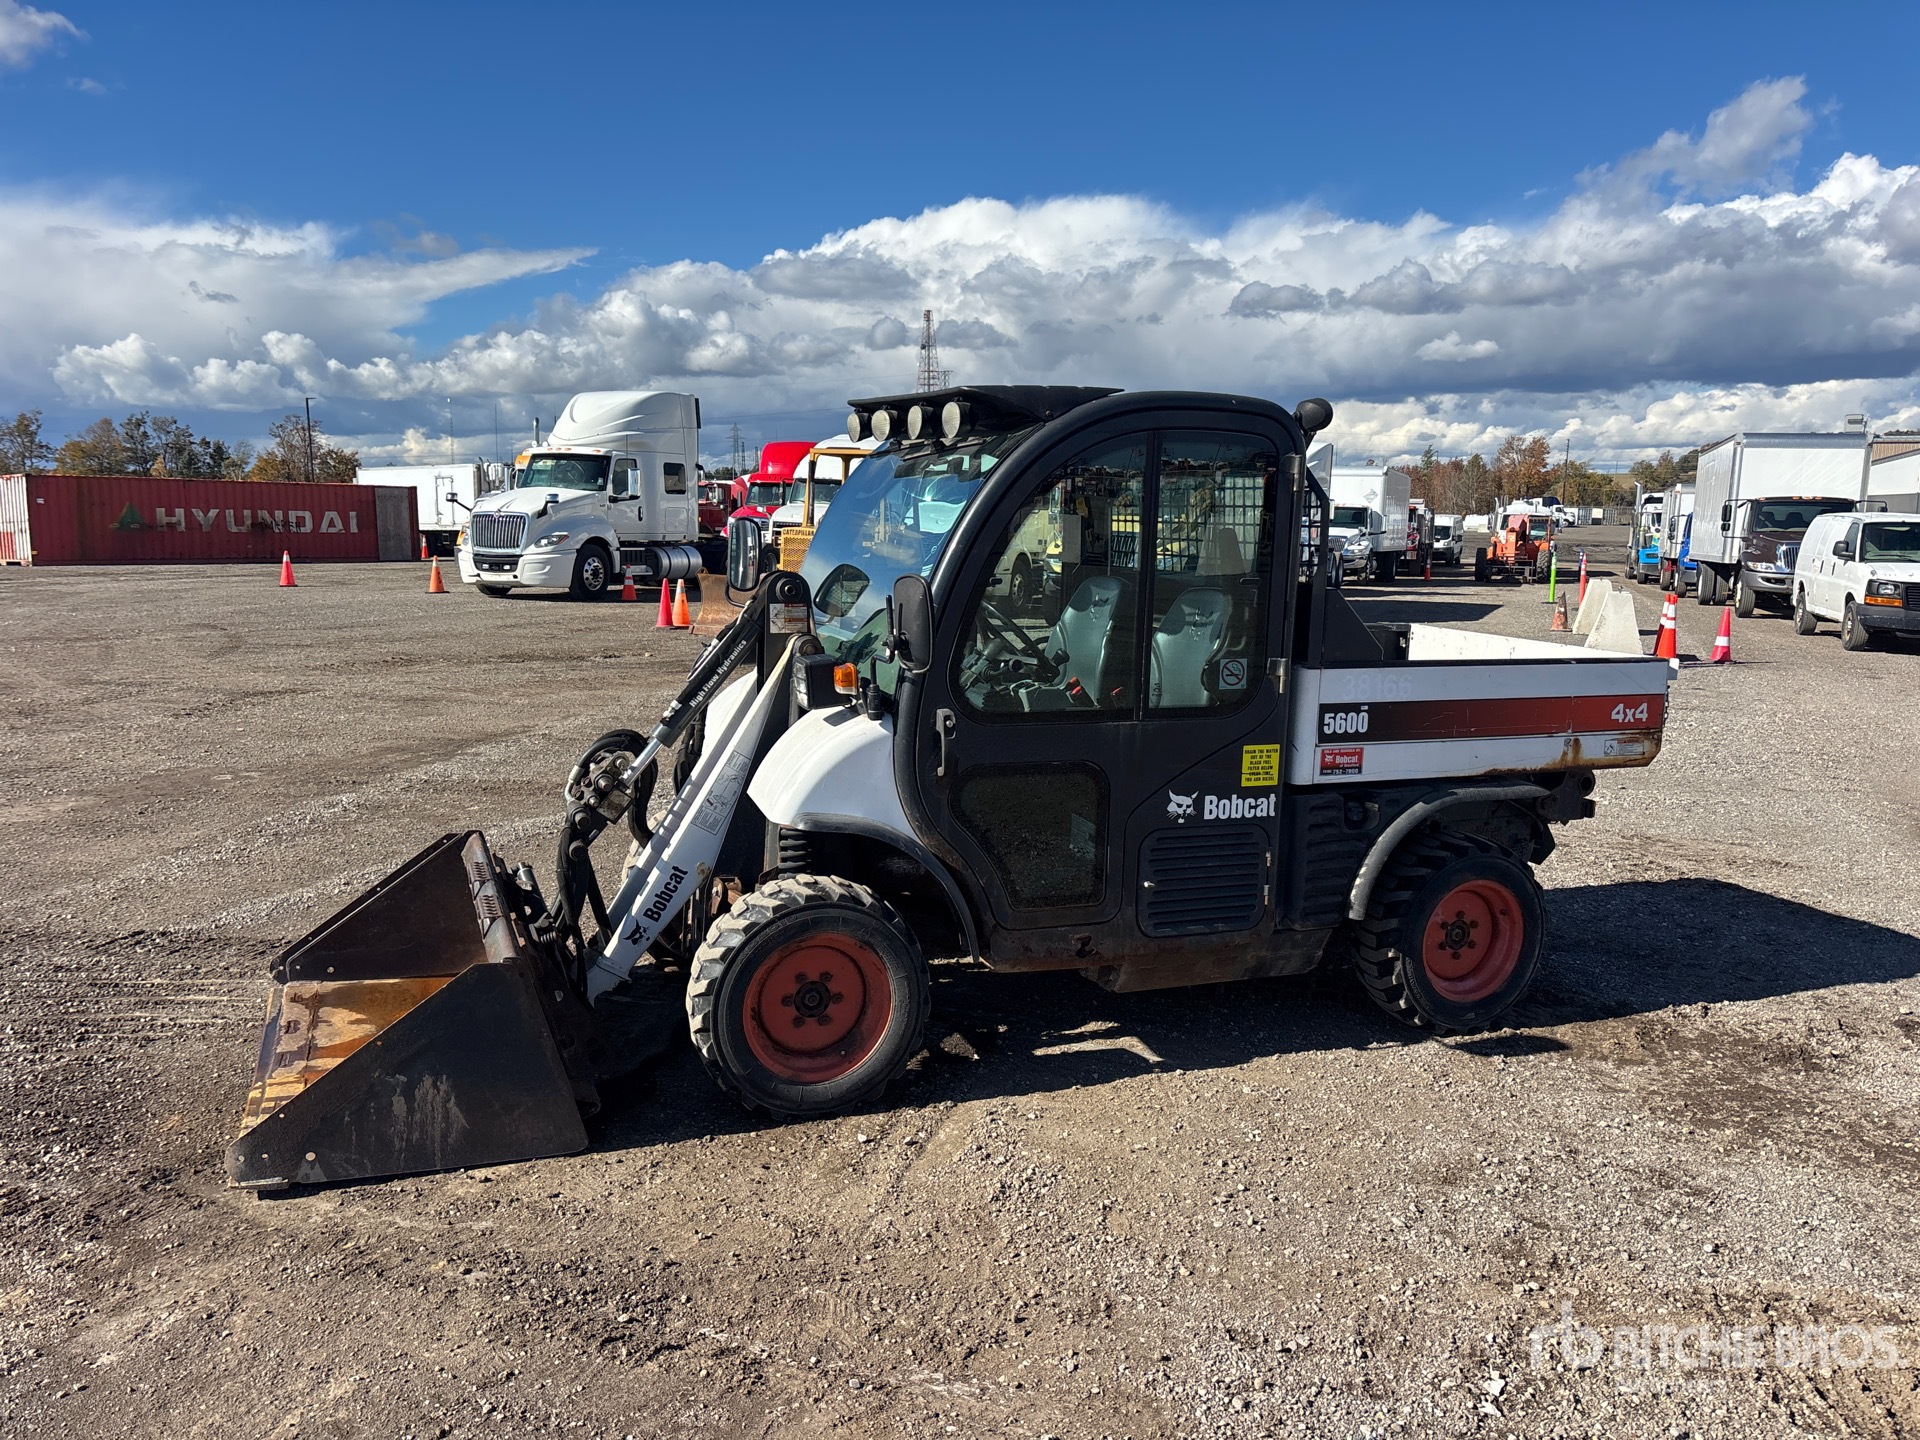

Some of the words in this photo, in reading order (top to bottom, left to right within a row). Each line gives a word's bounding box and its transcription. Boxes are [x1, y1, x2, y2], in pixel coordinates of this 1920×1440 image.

[155, 507, 358, 533] HYUNDAI
[782, 528, 815, 536] CATERPILLAR
[689, 690, 706, 707] High
[702, 674, 719, 692] Flow
[716, 639, 747, 675] Hydraulics
[1323, 711, 1369, 734] 5600
[1611, 702, 1648, 723] 4x4
[1335, 754, 1359, 764] Bobcat
[1203, 793, 1277, 820] Bobcat
[642, 865, 689, 923] Bobcat
